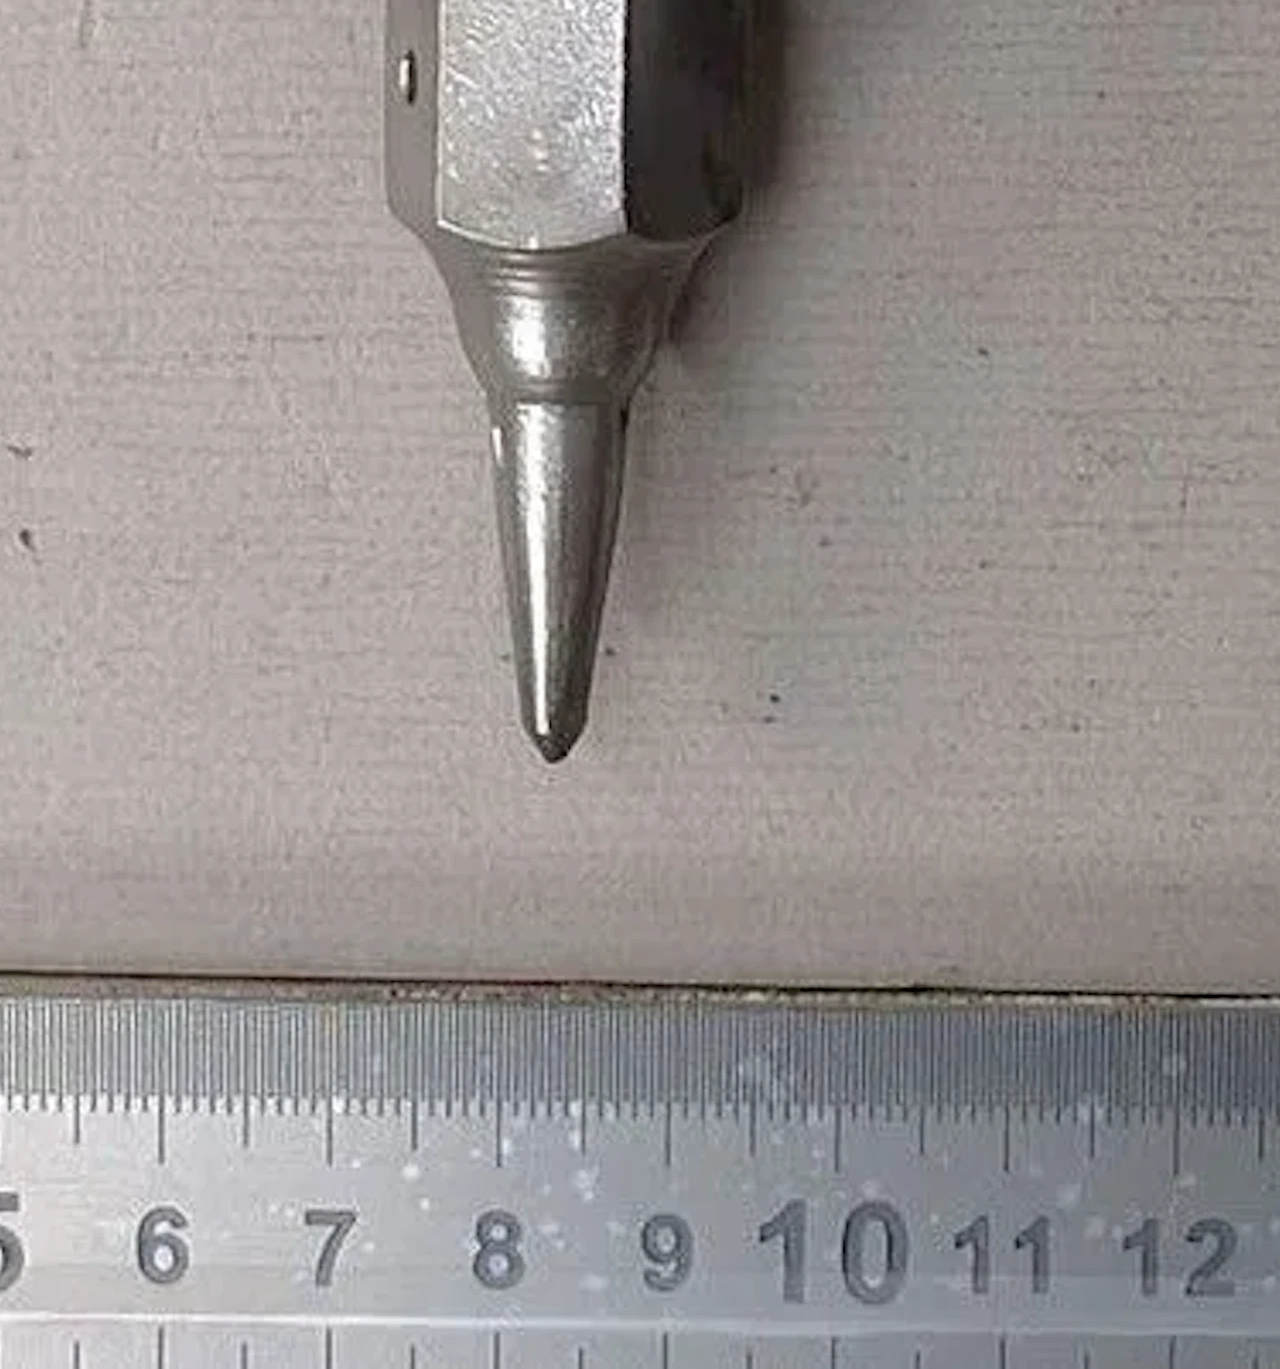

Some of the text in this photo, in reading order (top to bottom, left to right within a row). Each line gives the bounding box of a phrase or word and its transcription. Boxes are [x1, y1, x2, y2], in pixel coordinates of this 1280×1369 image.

[137, 1207, 189, 1284] 6
[305, 1210, 357, 1287] 7
[472, 1211, 523, 1289] 8
[641, 1214, 693, 1291] 9
[758, 1200, 908, 1304] 10
[953, 1216, 1051, 1294] 11
[1122, 1219, 1237, 1297] 12
